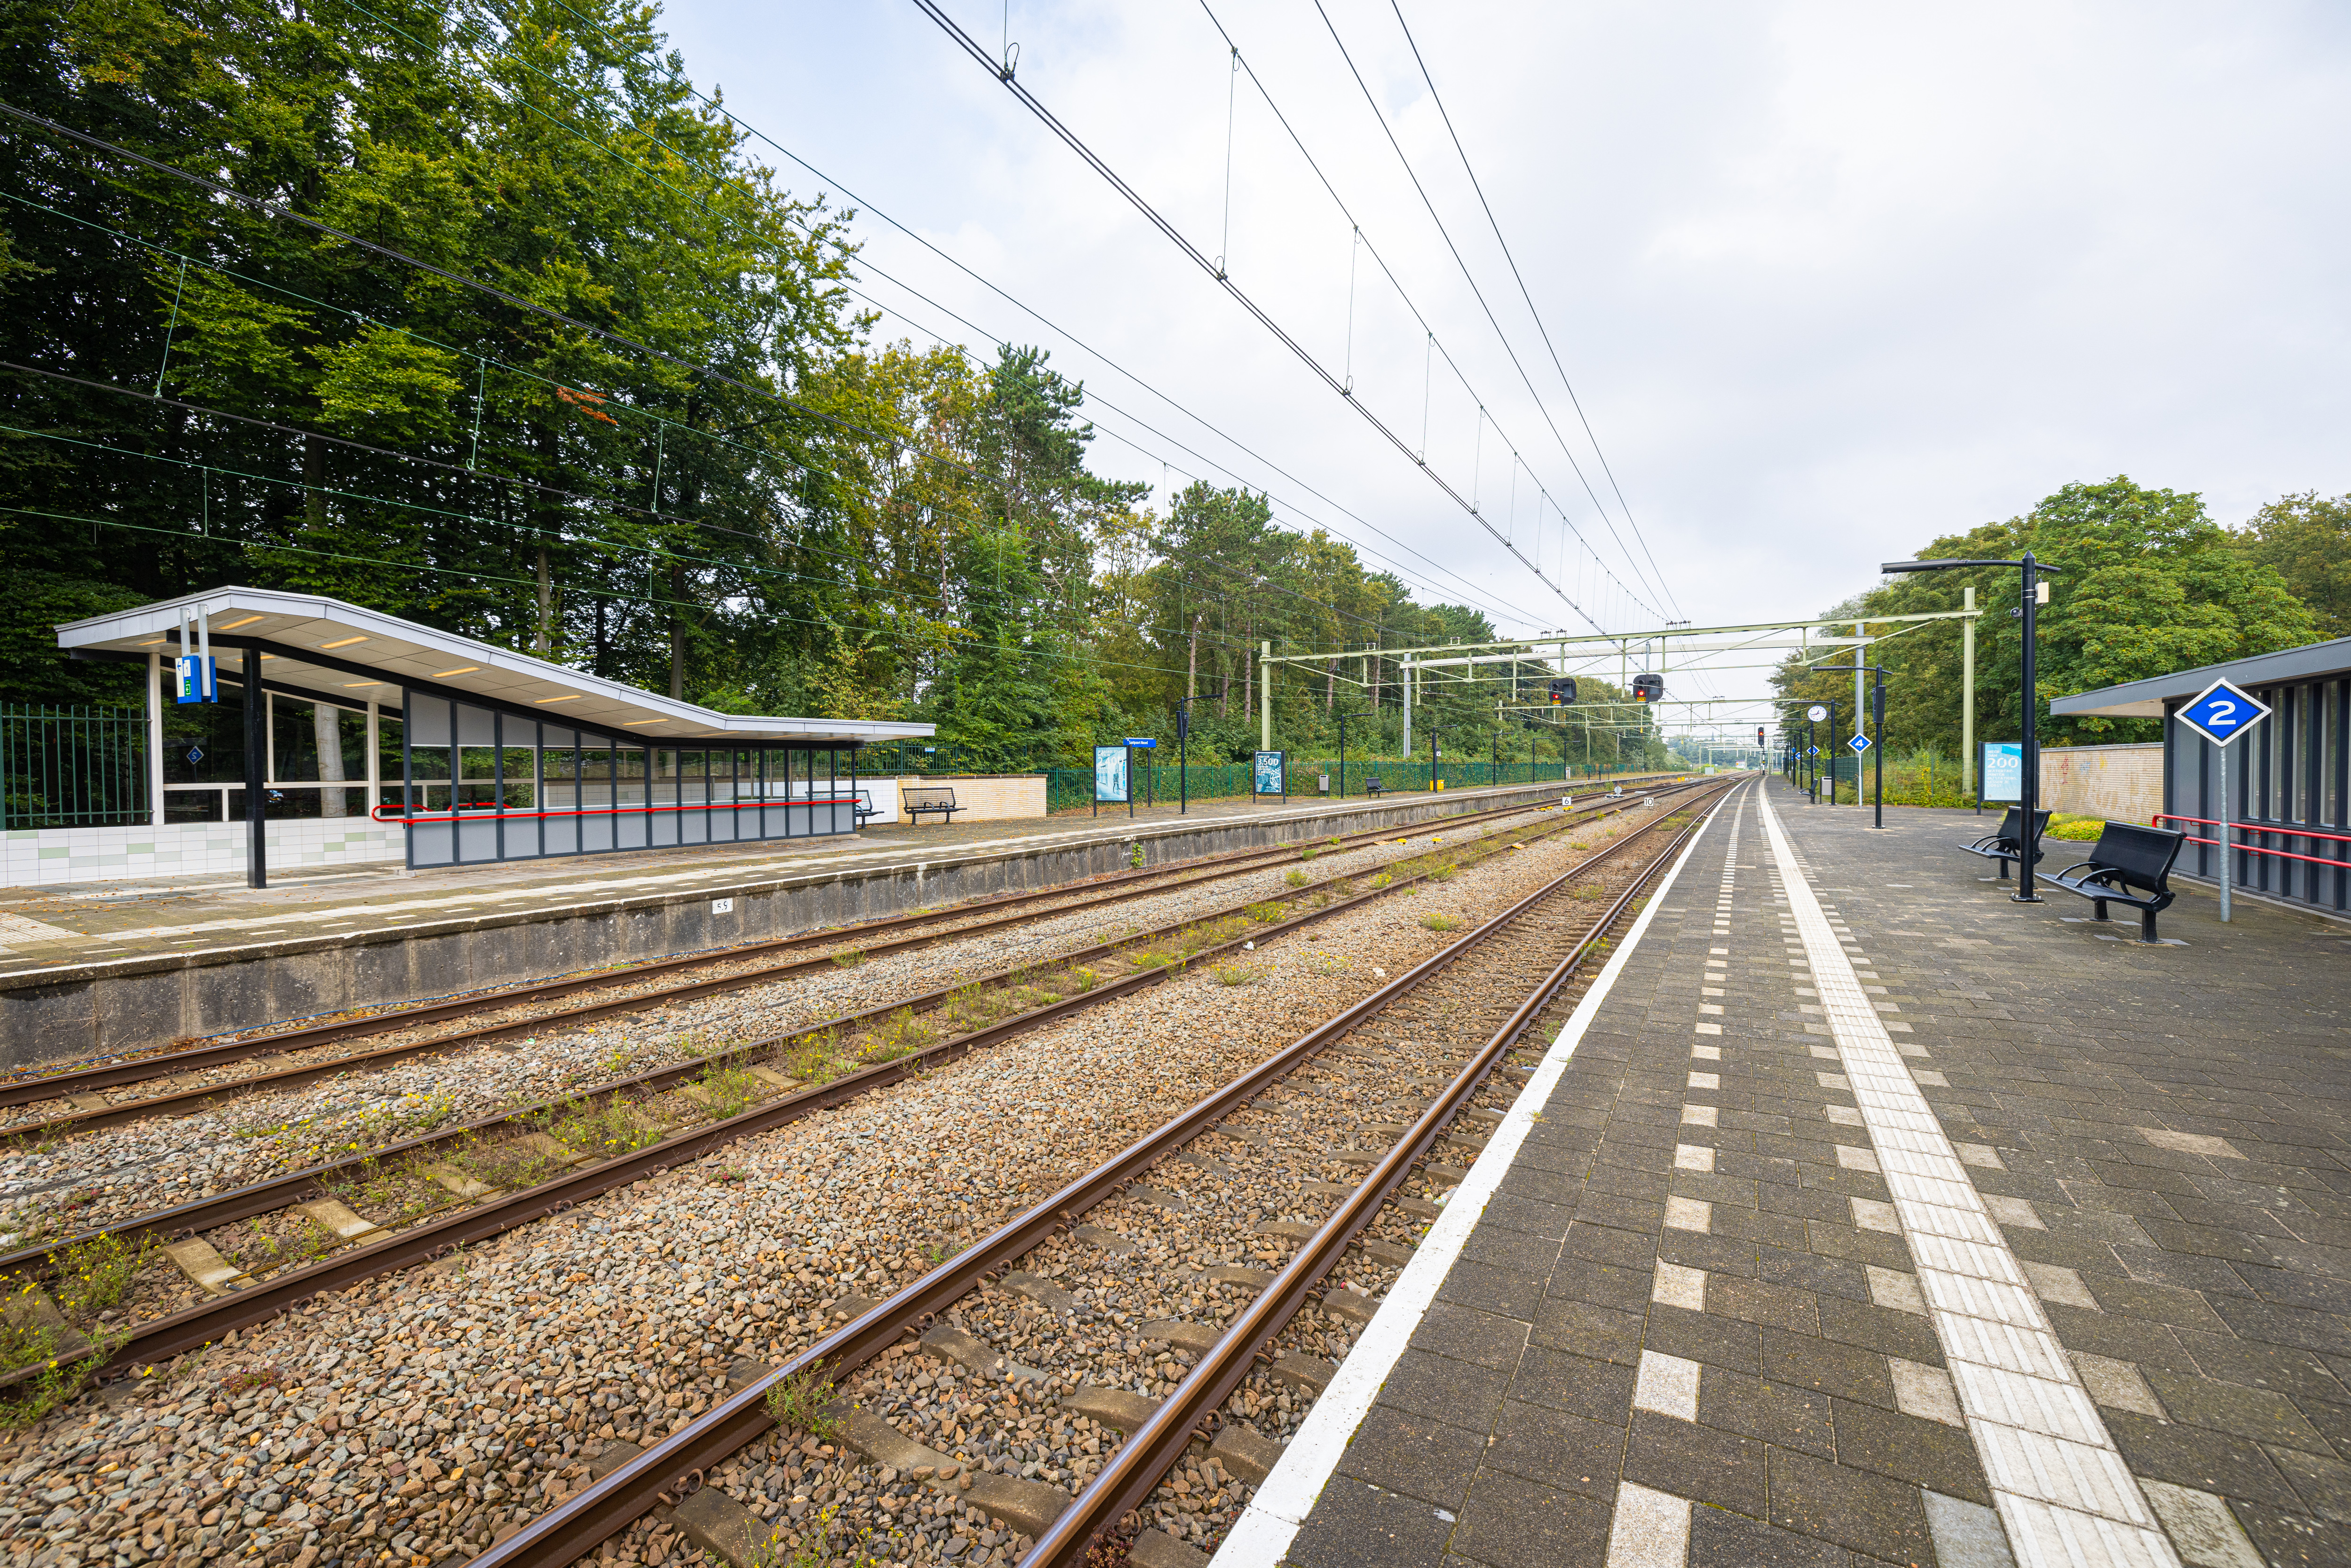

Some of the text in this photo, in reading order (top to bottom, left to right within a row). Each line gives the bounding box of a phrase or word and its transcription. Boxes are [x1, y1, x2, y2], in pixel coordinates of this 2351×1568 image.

[186, 666, 188, 675] 1
[2208, 701, 2236, 725] 2
[1098, 757, 1123, 766] 2.400
[1987, 758, 2018, 768] 200
[717, 901, 728, 910] 5.9
